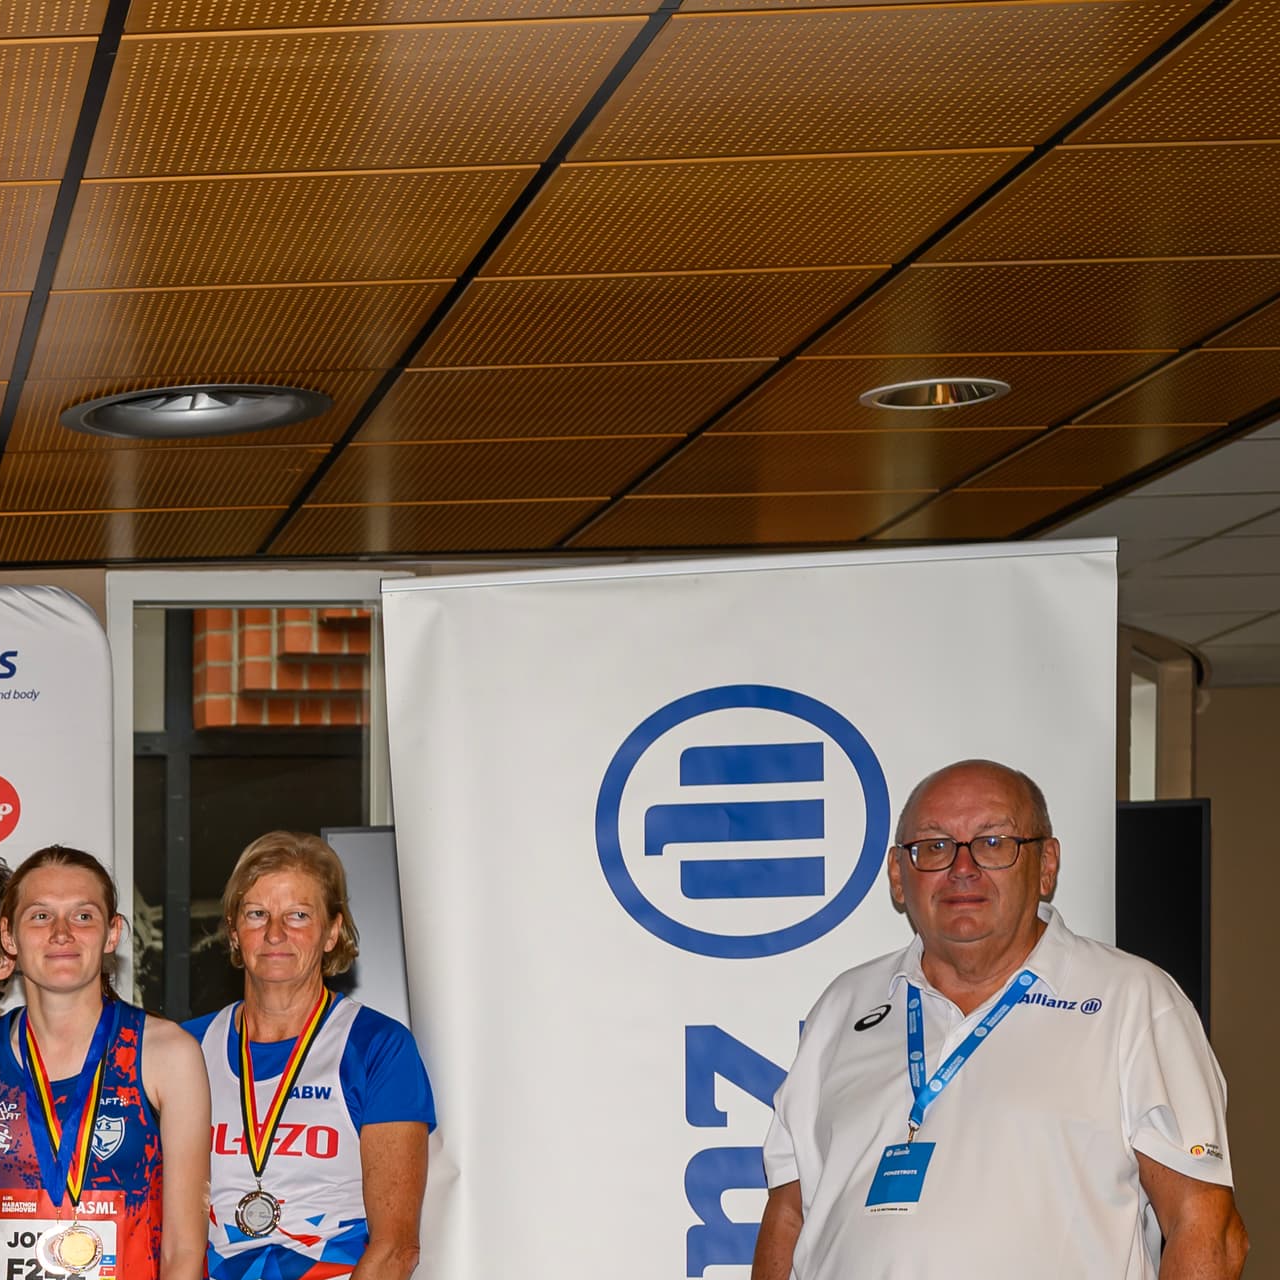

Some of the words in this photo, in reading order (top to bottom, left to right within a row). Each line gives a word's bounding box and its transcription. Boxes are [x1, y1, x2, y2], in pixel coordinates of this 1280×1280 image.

[13, 689, 40, 702] body
[1017, 992, 1078, 1010] Allianz
[288, 1086, 332, 1100] ABW
[76, 1201, 117, 1215] ASML
[7, 1231, 43, 1248] JO
